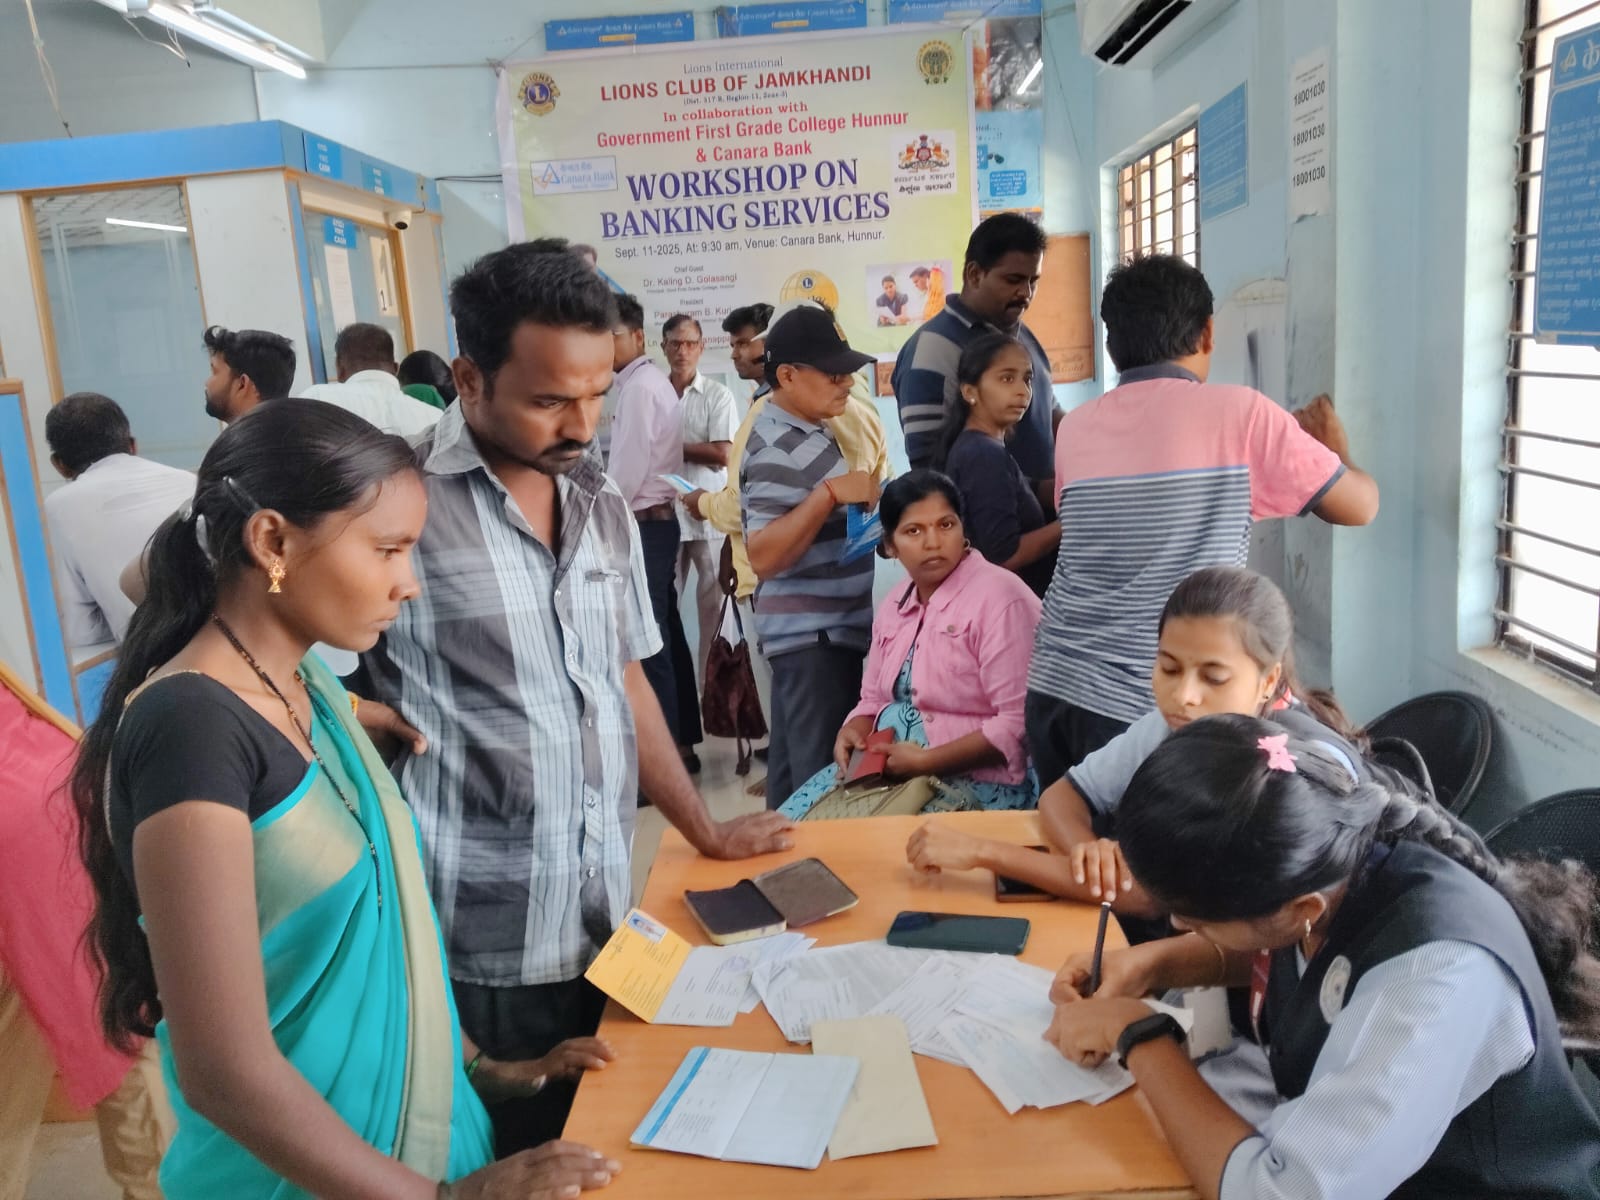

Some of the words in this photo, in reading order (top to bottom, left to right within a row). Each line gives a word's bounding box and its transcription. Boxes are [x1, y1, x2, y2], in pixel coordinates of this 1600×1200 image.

[683, 62, 711, 74] Lions
[715, 56, 784, 72] International
[601, 82, 658, 101] LIONS
[666, 77, 717, 95] CLUB
[724, 74, 748, 91] OF
[755, 65, 871, 90] JAMKHANDI
[726, 93, 749, 102] Region
[664, 112, 677, 122] In
[682, 103, 773, 120] collaboration
[778, 101, 808, 114] with
[597, 128, 690, 147] Government
[696, 123, 731, 140] First
[736, 120, 783, 137] Grade
[788, 114, 846, 134] College
[852, 112, 909, 128] Hunnur
[1293, 123, 1325, 147] 18001030
[696, 147, 707, 163] &
[713, 146, 768, 161] Canara
[774, 140, 812, 157] Bank
[626, 162, 807, 201] WORKSHOP
[815, 159, 858, 188] ON
[1293, 165, 1326, 187] 18001030
[600, 203, 738, 238] BANKING
[744, 192, 890, 228] SERVICES
[615, 247, 639, 259] Sept.
[643, 242, 683, 256] 11-2025,
[686, 242, 699, 253] At:
[701, 241, 722, 252] 9:30
[725, 241, 742, 252] am,
[744, 237, 778, 250] Venue:
[781, 235, 815, 247] Canara
[818, 232, 845, 245] Bank,
[847, 230, 885, 242] Hunnur.
[643, 279, 655, 288] Dr.
[685, 275, 695, 285] D.
[697, 272, 738, 284] Golasangi
[704, 307, 714, 316] B.
